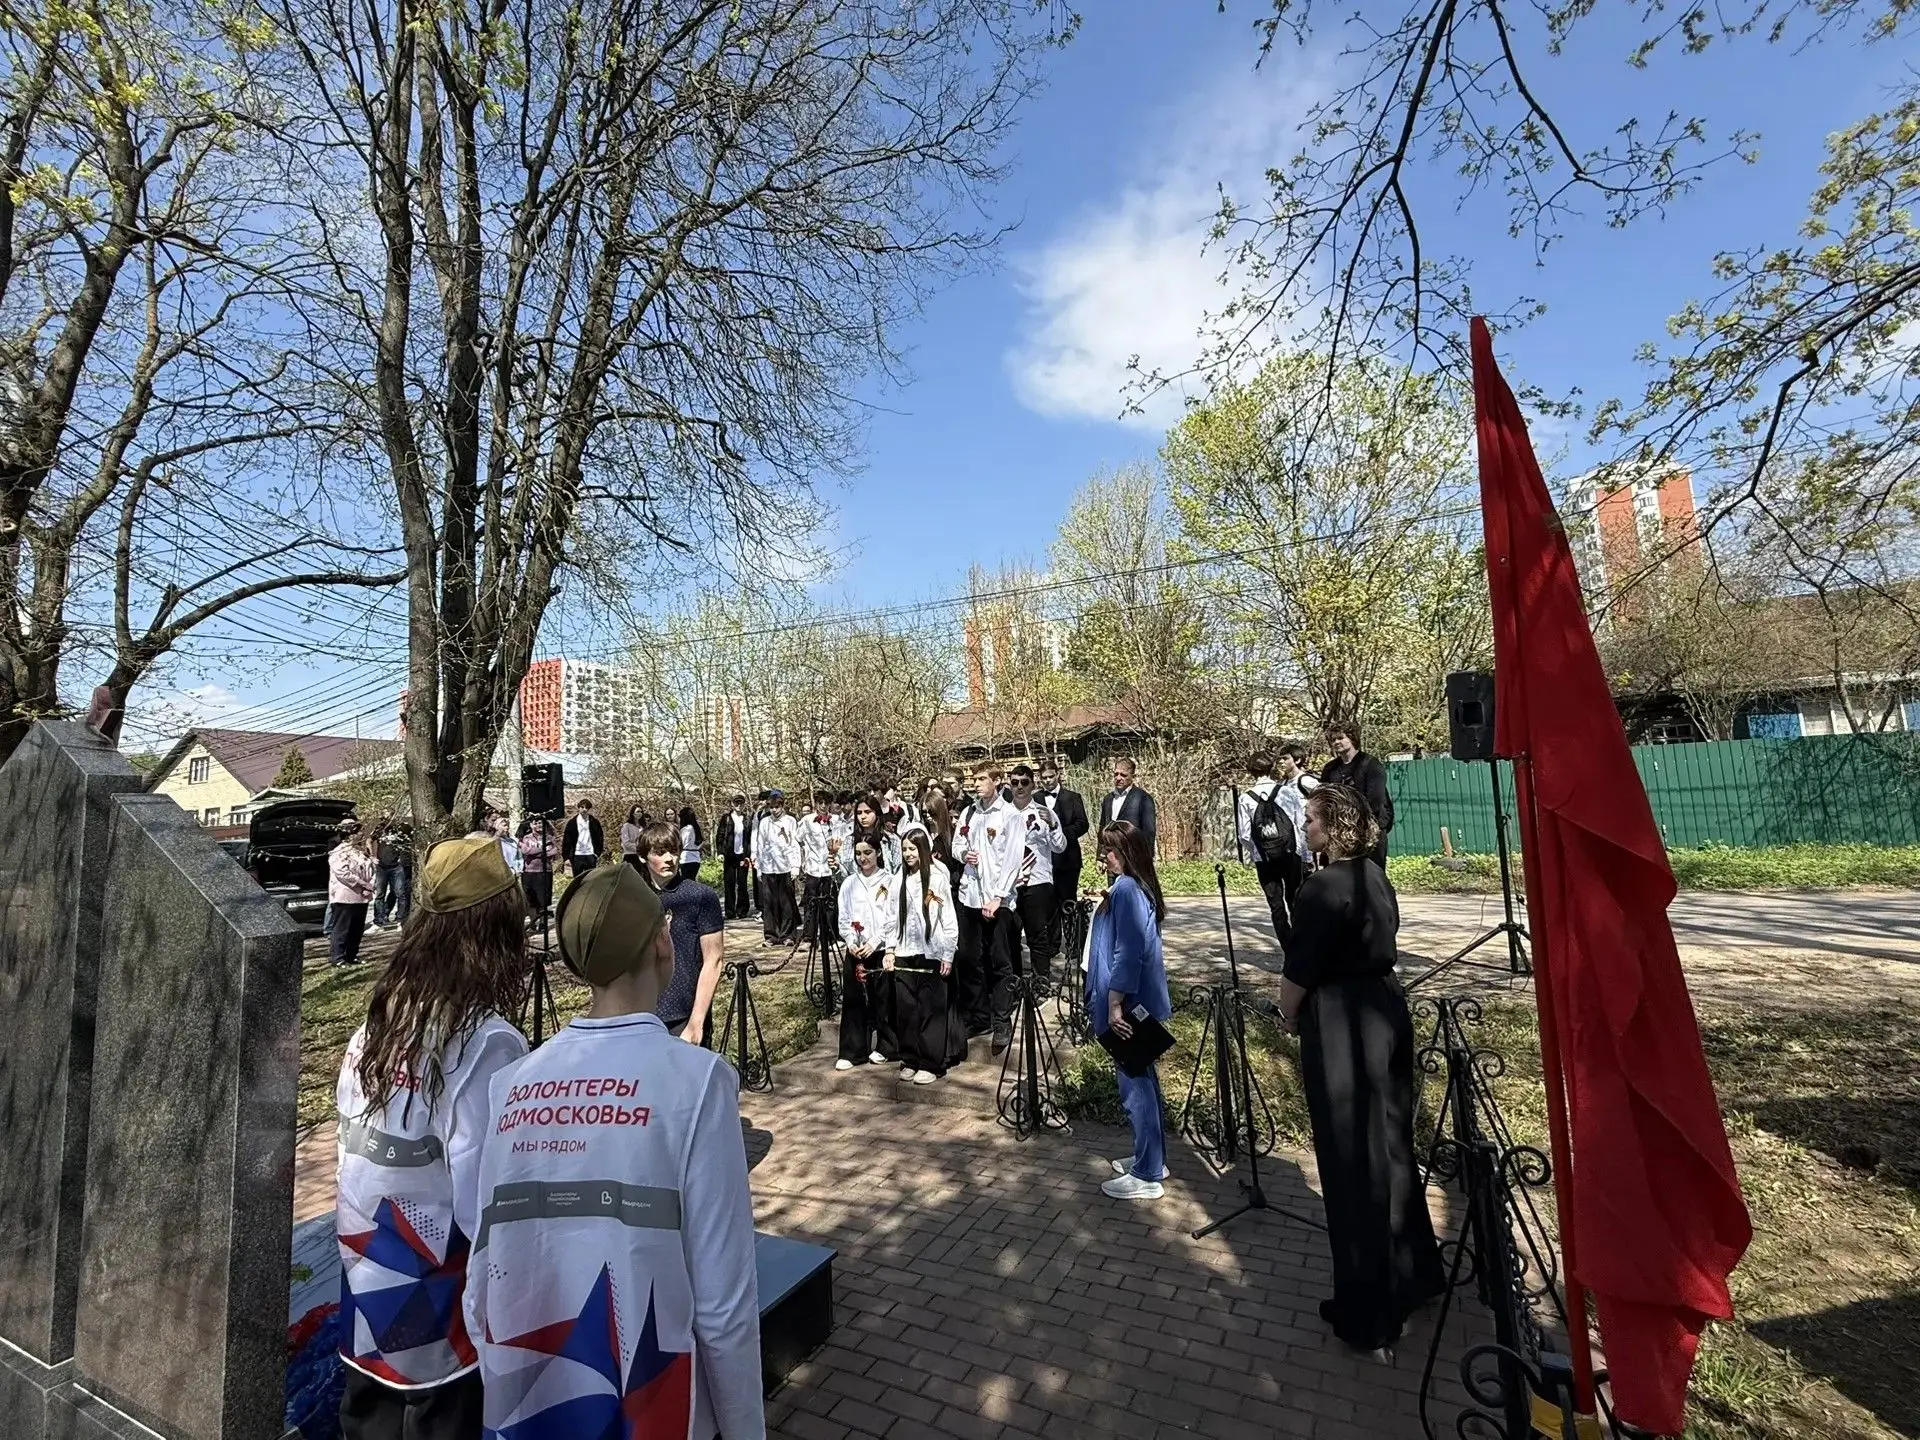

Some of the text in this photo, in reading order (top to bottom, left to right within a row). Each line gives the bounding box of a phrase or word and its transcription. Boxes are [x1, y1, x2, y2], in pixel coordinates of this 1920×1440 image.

[504, 1078, 640, 1107] ВОЛОНТЕРЫ
[512, 1140, 587, 1154] МЫ РЯДОМ
